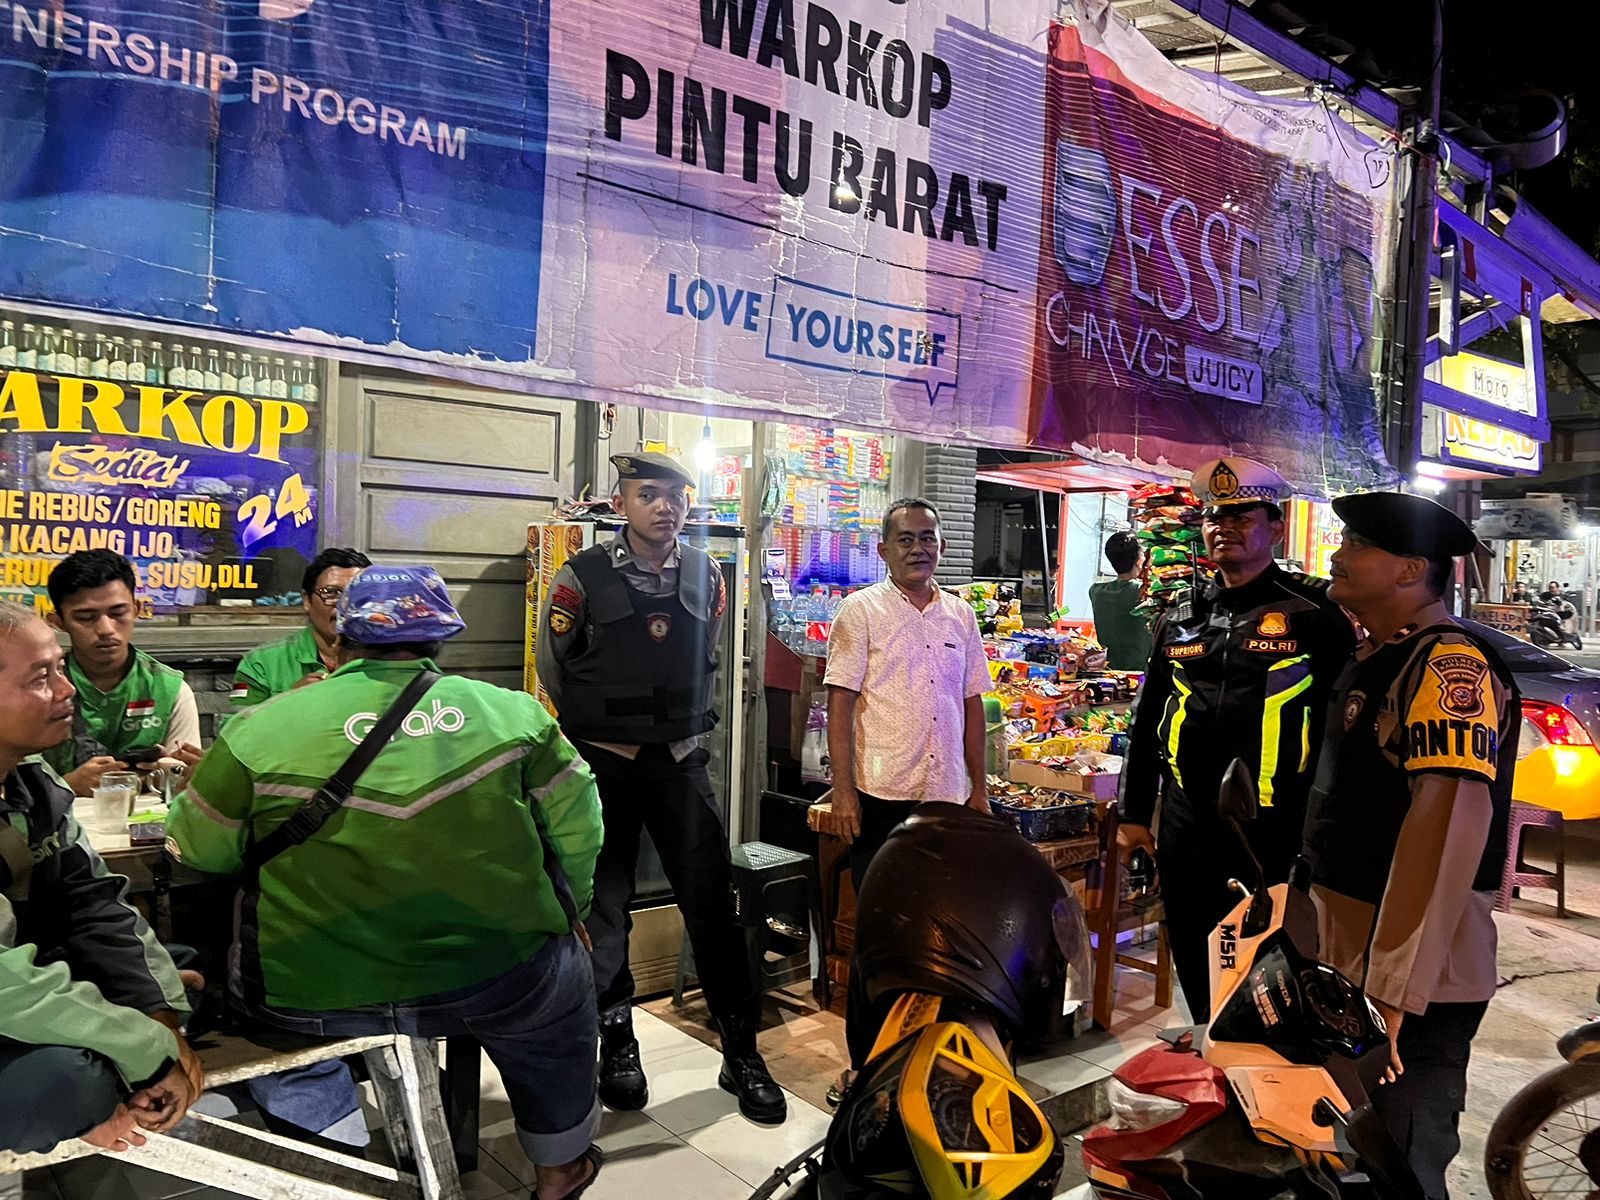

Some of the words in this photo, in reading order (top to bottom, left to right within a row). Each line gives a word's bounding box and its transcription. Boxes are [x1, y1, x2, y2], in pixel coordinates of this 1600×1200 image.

[1, 2, 238, 92] NERSHIP
[251, 66, 467, 161] PROGRAM
[700, 0, 953, 128] WARKOP
[604, 48, 813, 198] PINTU
[828, 130, 1008, 252] BARAT
[1118, 174, 1264, 343] ESSE
[666, 272, 762, 333] LOVE
[786, 303, 947, 367] YOURSELF
[1046, 290, 1186, 387] CHANGE
[1192, 355, 1255, 394] JUICY
[0, 369, 309, 465] ARKOP
[9, 524, 126, 556] KACANG
[132, 530, 173, 559] IJO
[237, 472, 311, 548] 24
[1249, 640, 1292, 651] POLRI
[121, 714, 163, 732] Grab
[344, 698, 466, 747] Gab
[1219, 923, 1237, 970] MSR
